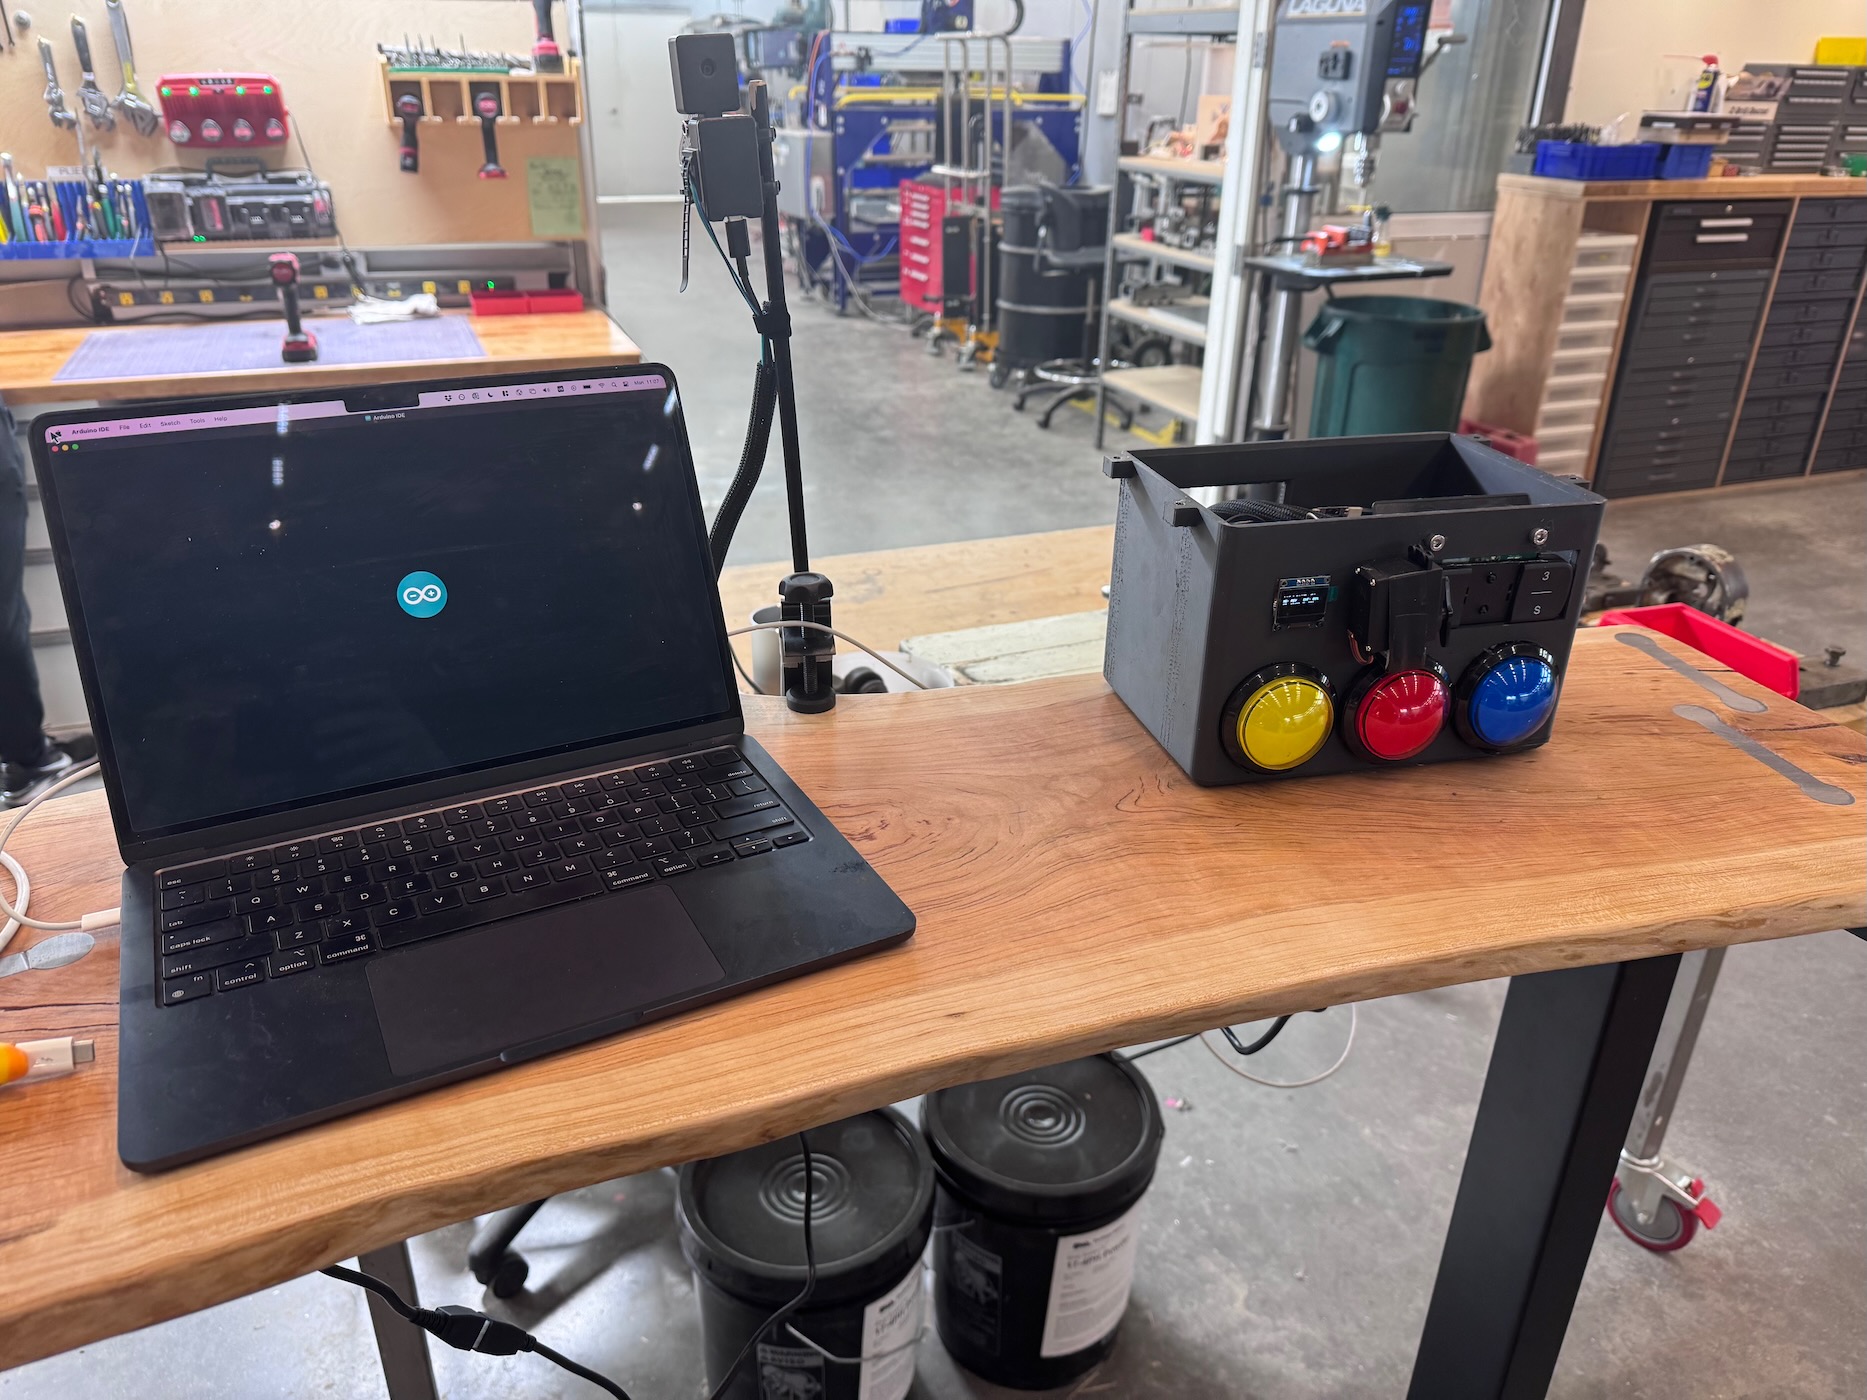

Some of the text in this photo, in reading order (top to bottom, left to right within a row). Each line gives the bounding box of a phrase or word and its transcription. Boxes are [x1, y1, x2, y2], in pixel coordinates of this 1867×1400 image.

[1542, 571, 1550, 581] 3
[1533, 605, 1541, 615] S
[664, 864, 687, 872] option
[613, 872, 648, 885] command
[295, 931, 303, 939] Z
[170, 942, 191, 950] caps
[327, 944, 368, 959] command
[171, 964, 192, 973] shift
[279, 961, 307, 971] option
[224, 973, 256, 985] control
